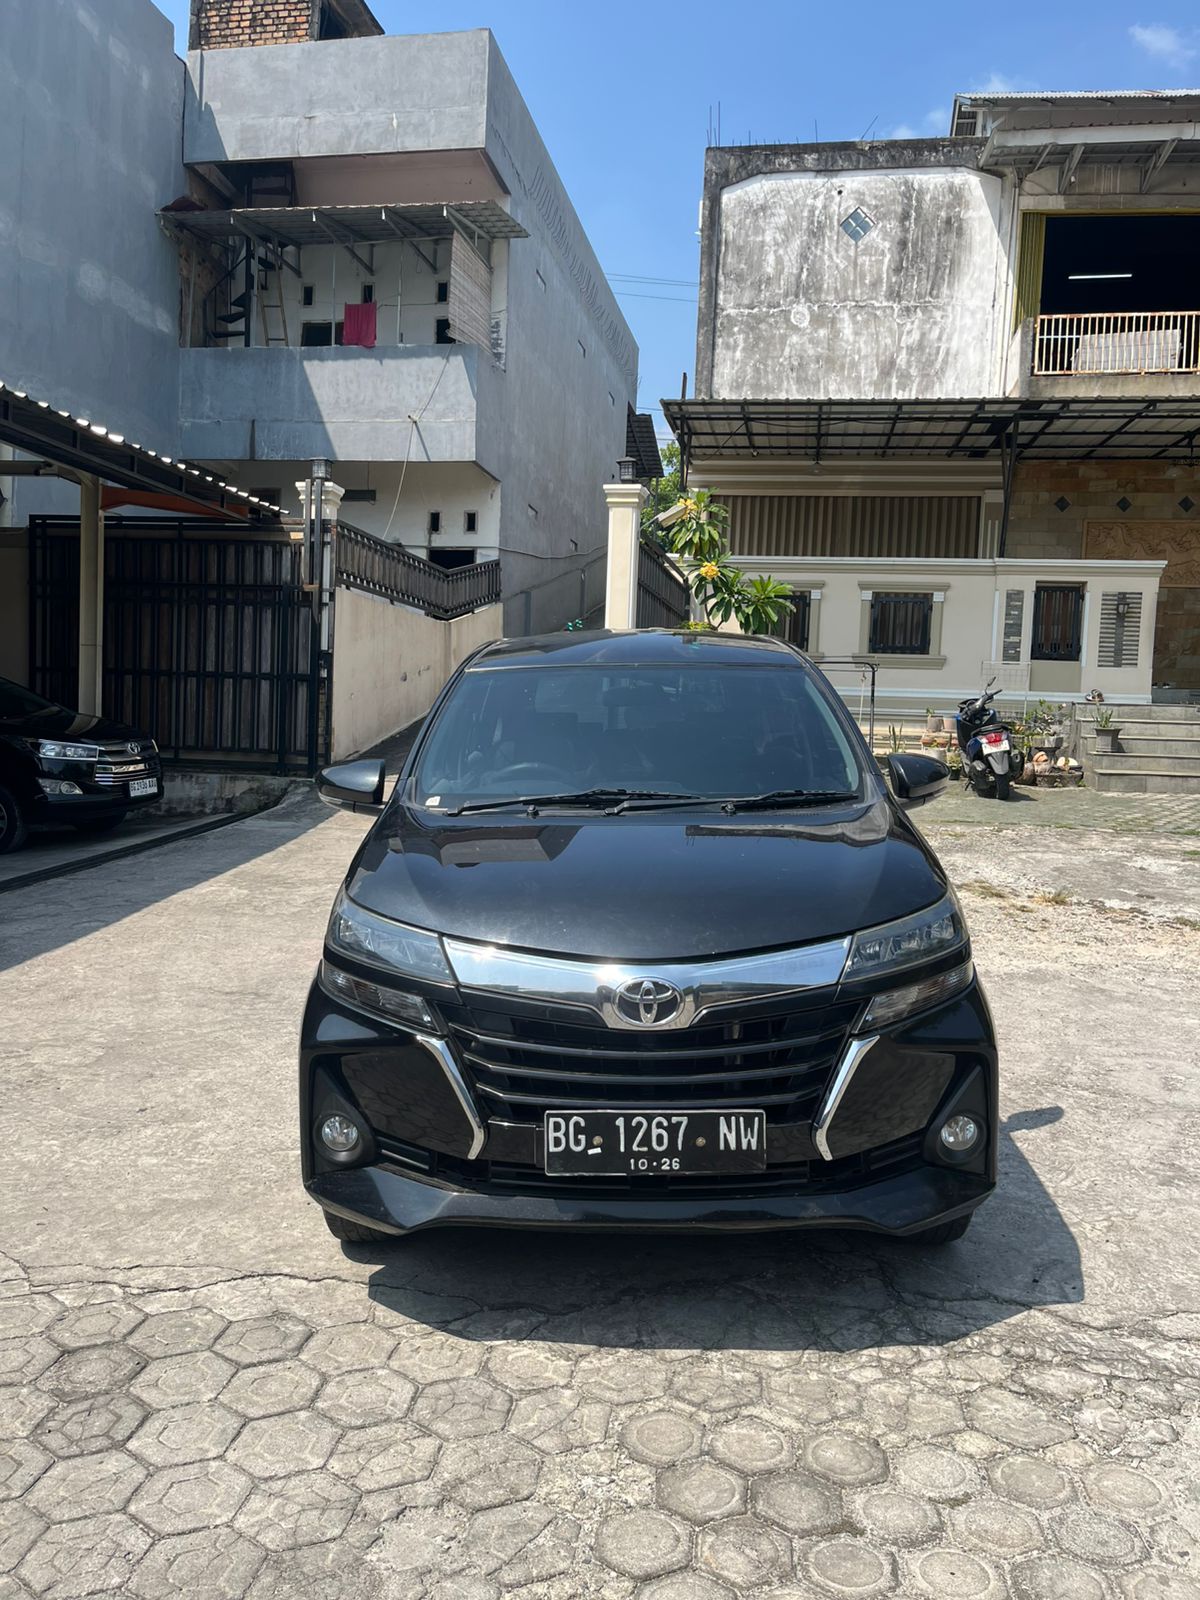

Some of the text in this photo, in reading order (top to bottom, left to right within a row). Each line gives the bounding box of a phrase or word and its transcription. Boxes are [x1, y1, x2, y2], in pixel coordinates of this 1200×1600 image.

[549, 1116, 759, 1152] BG 1267 NW
